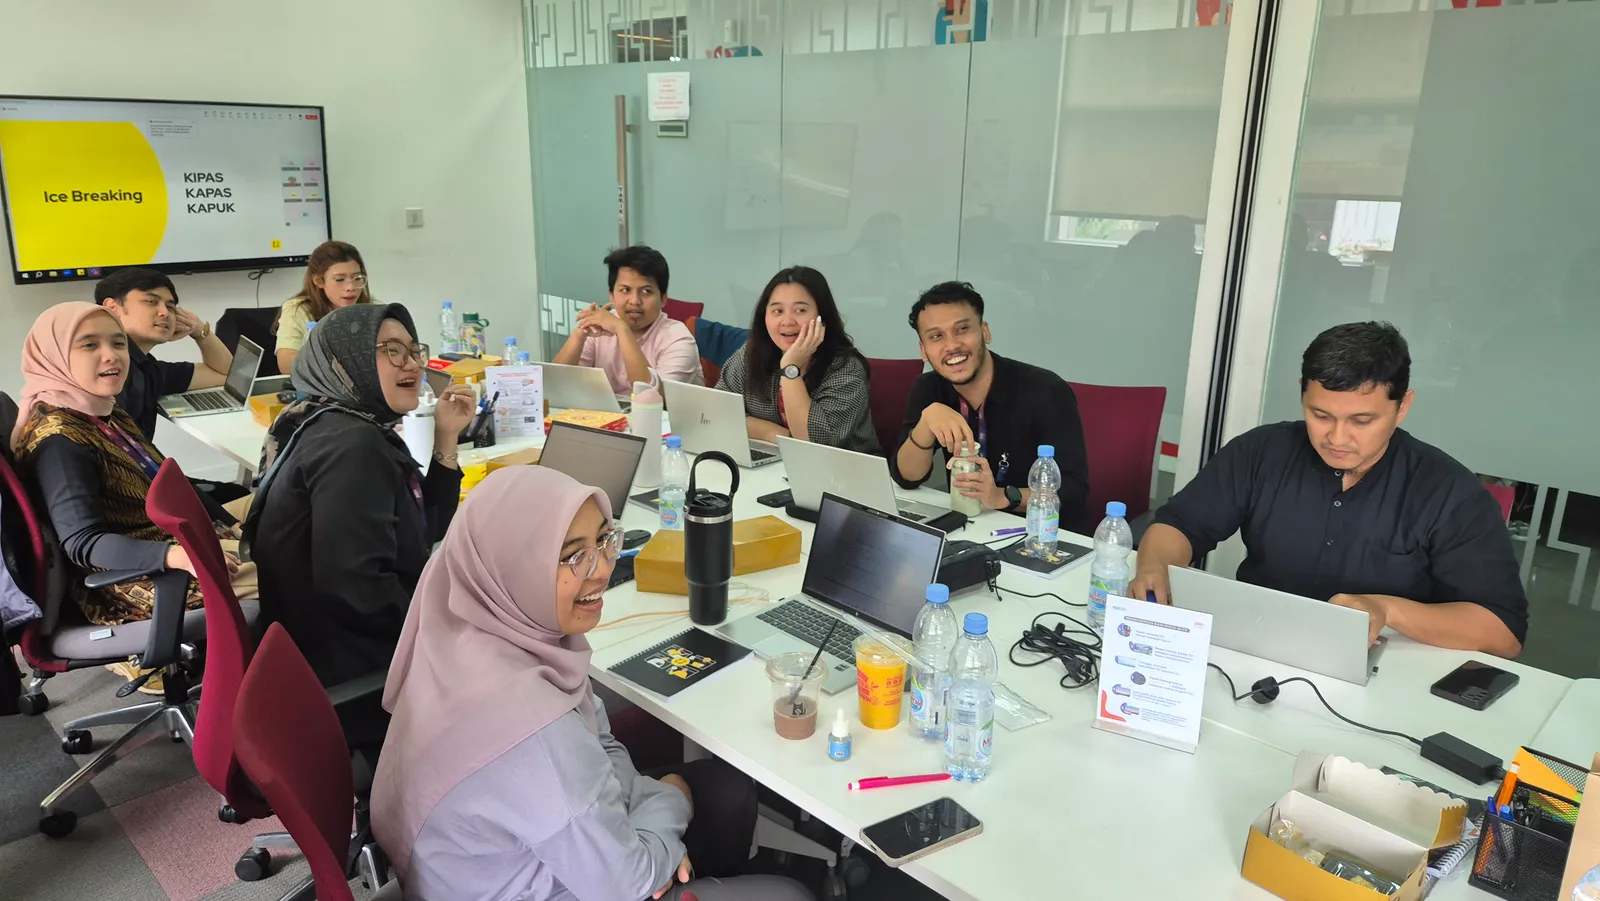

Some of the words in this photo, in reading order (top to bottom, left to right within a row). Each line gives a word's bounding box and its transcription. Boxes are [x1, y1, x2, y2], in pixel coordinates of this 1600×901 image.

[183, 172, 224, 183] KIPAS
[43, 190, 68, 203] Ice
[71, 188, 143, 204] Breaking
[185, 187, 232, 199] KAPAS
[187, 202, 236, 214] KAPUK
